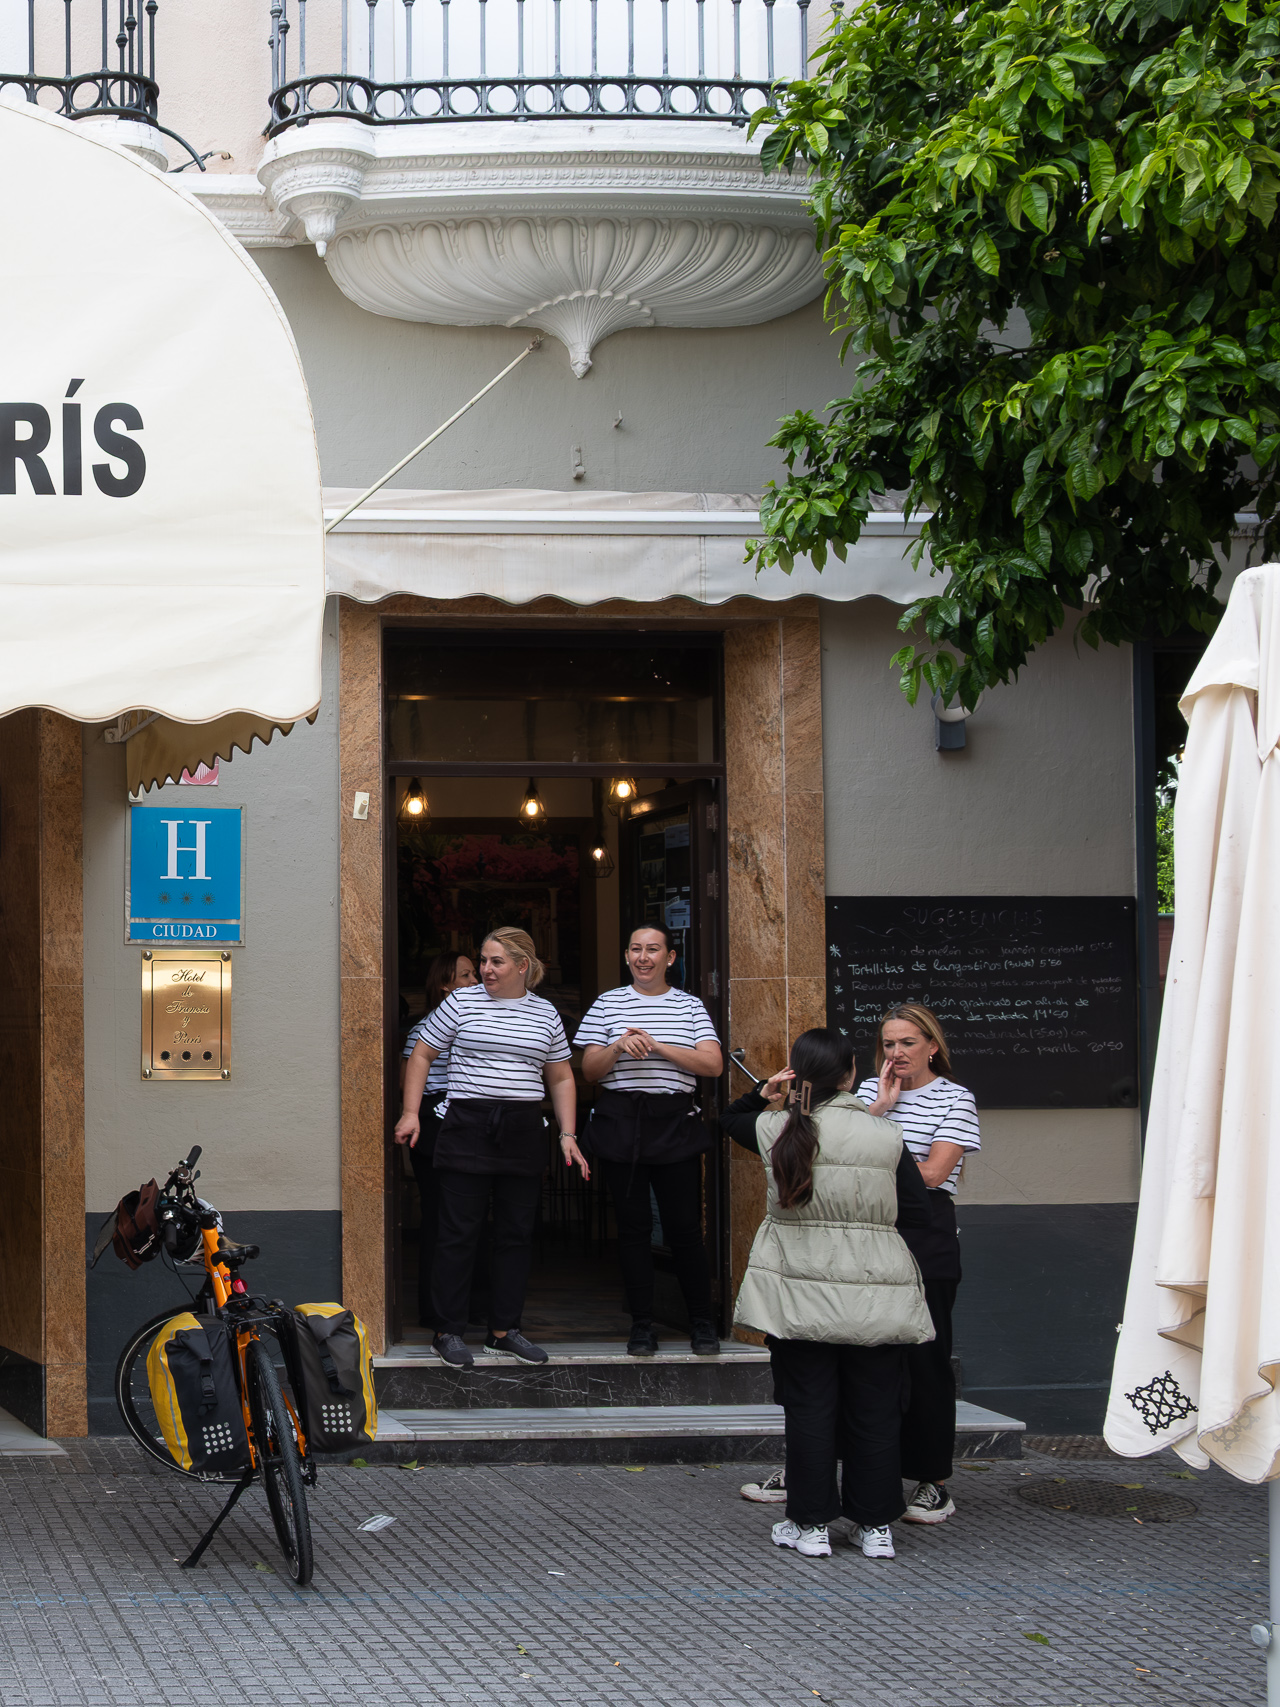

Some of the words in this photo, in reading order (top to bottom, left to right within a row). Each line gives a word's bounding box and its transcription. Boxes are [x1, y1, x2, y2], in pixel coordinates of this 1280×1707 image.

[160, 819, 212, 880] H
[902, 906, 1043, 927] SUGEENCIAS
[152, 925, 218, 938] CIUDAD
[847, 961, 905, 976] Tortillitas
[911, 960, 927, 972] de
[933, 958, 1002, 977] langostinos
[171, 969, 206, 982] Hotel
[181, 985, 194, 997] de
[851, 978, 904, 991] Revuelto
[907, 978, 923, 990] de
[165, 999, 210, 1013] Francia
[853, 997, 882, 1012] Lomo
[1015, 998, 1033, 1007] con
[1074, 997, 1090, 1007] de
[182, 1016, 191, 1027] y
[852, 1013, 884, 1023] eneld
[966, 1011, 983, 1021] de
[985, 1010, 1029, 1022] patata
